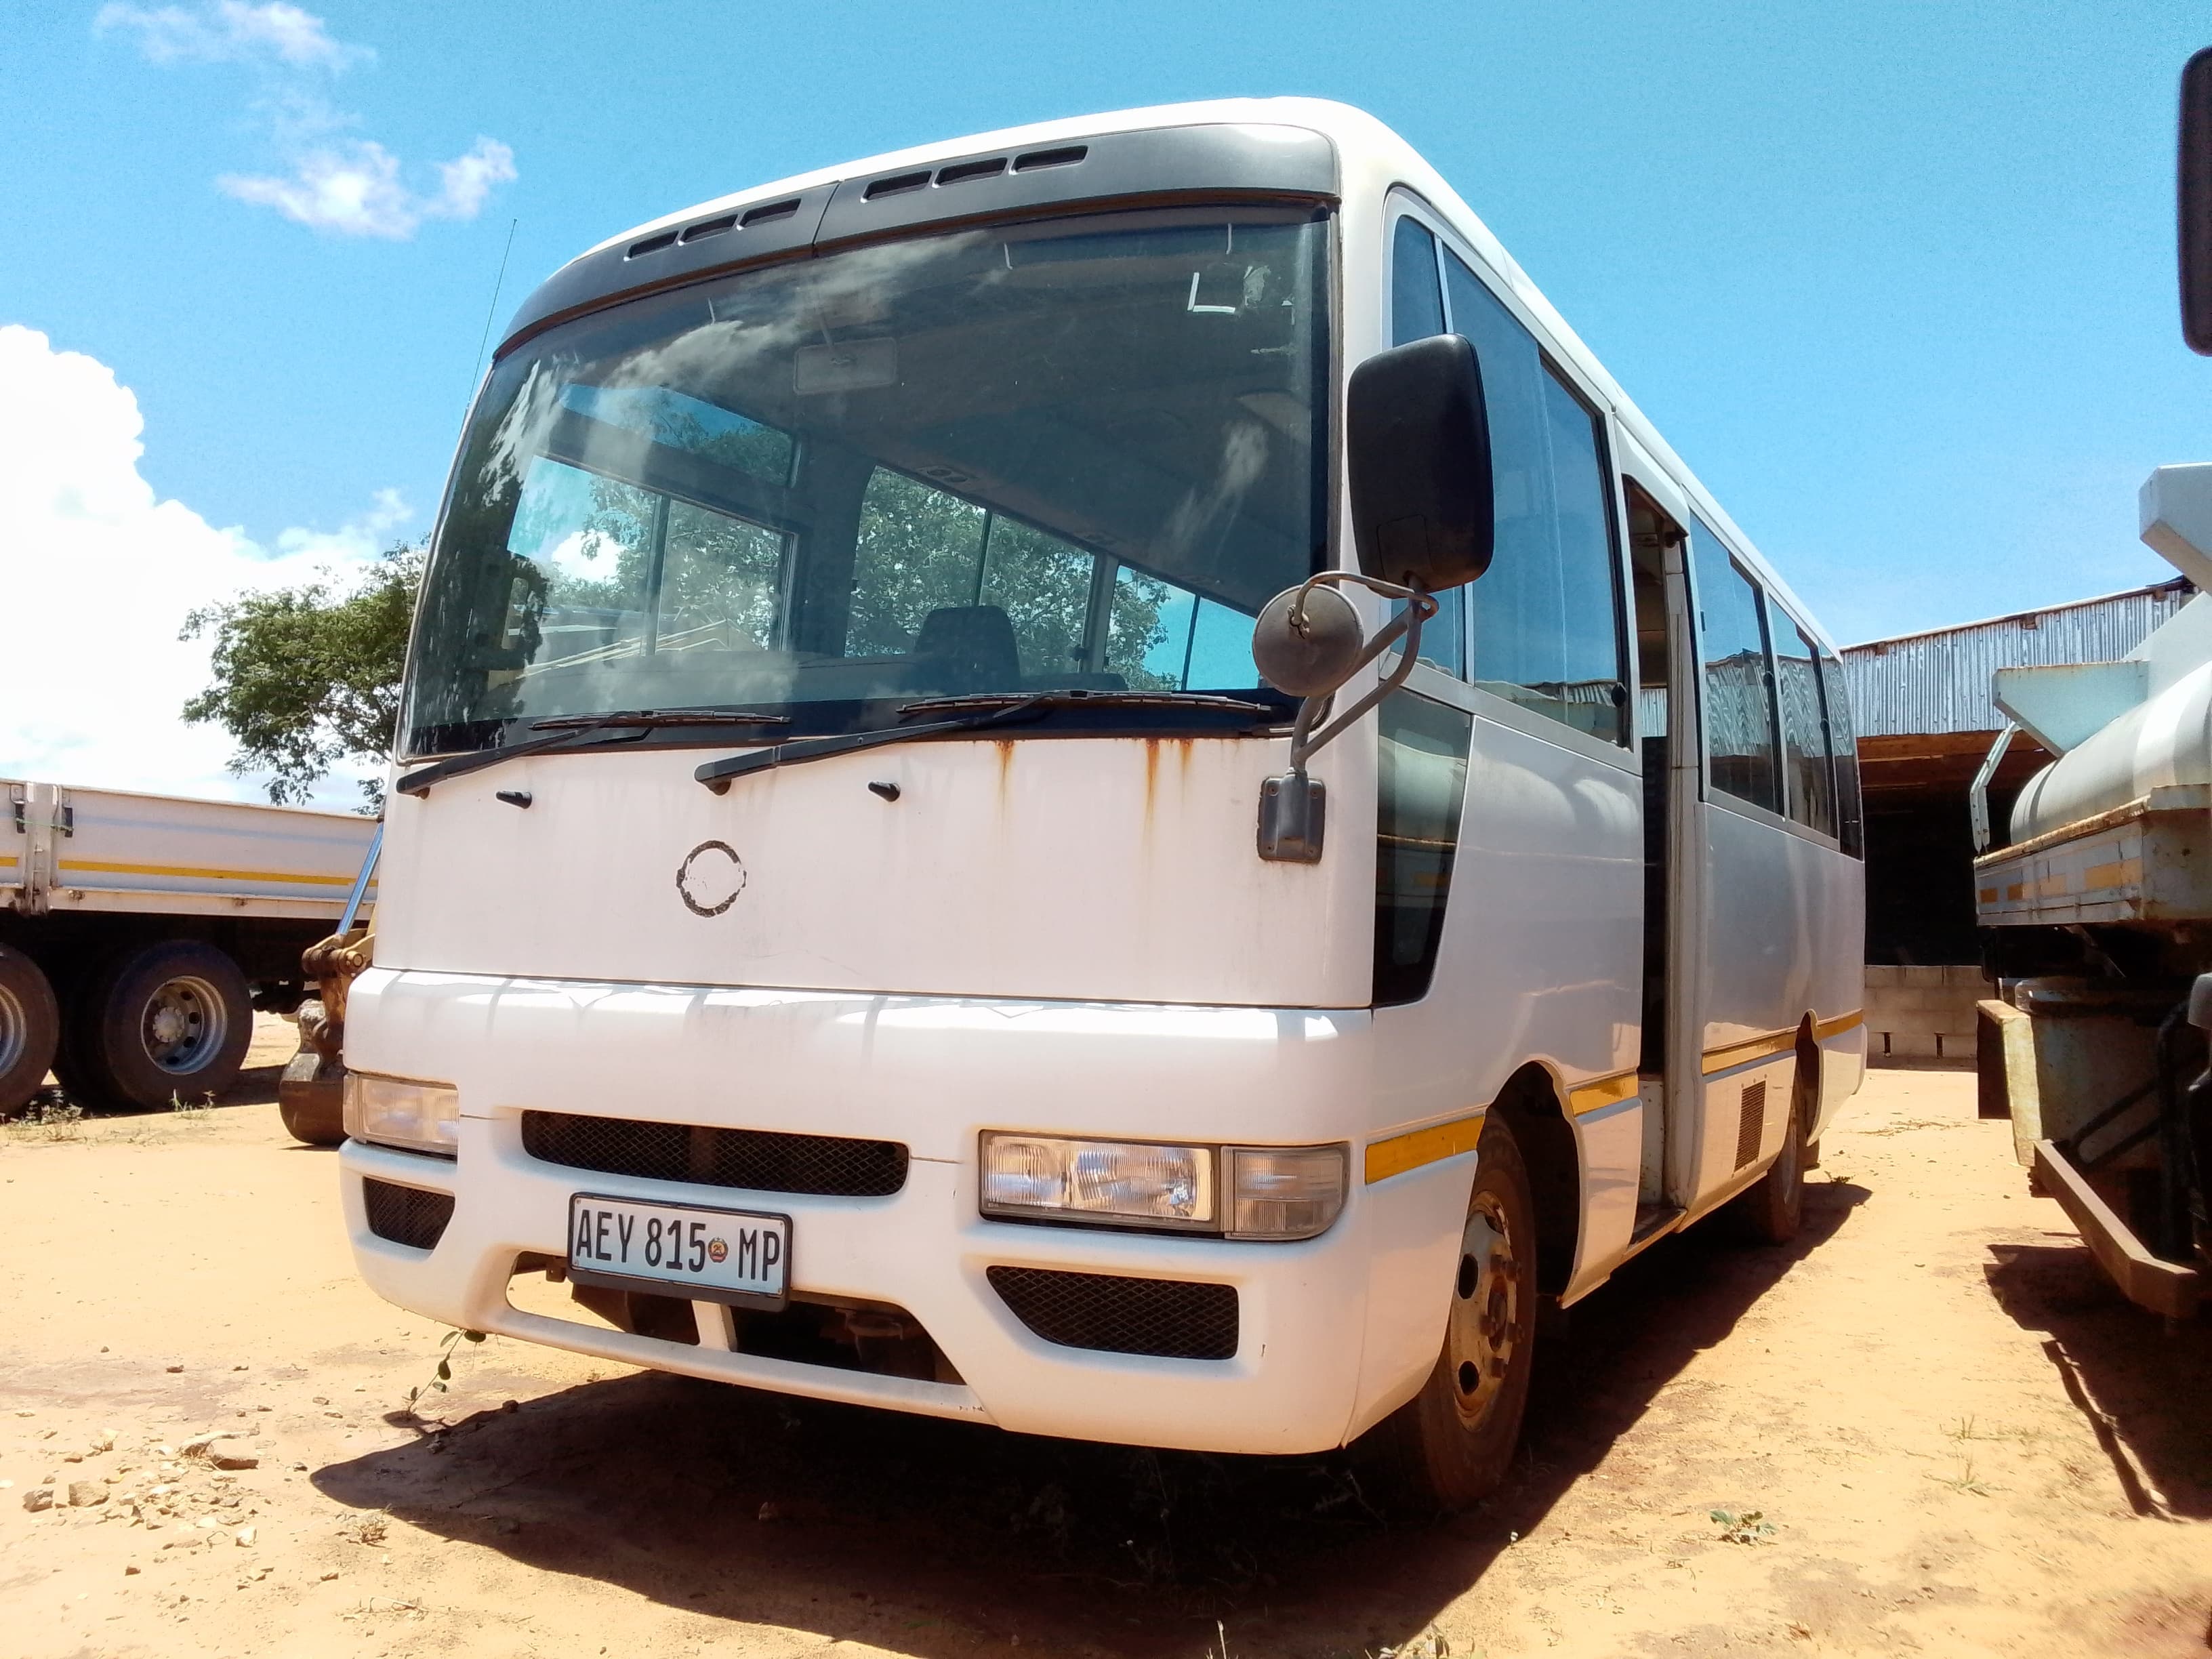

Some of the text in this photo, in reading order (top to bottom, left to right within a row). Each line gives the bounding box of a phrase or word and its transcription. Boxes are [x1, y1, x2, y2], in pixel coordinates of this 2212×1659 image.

[576, 1210, 780, 1282] AEY 815 MP
